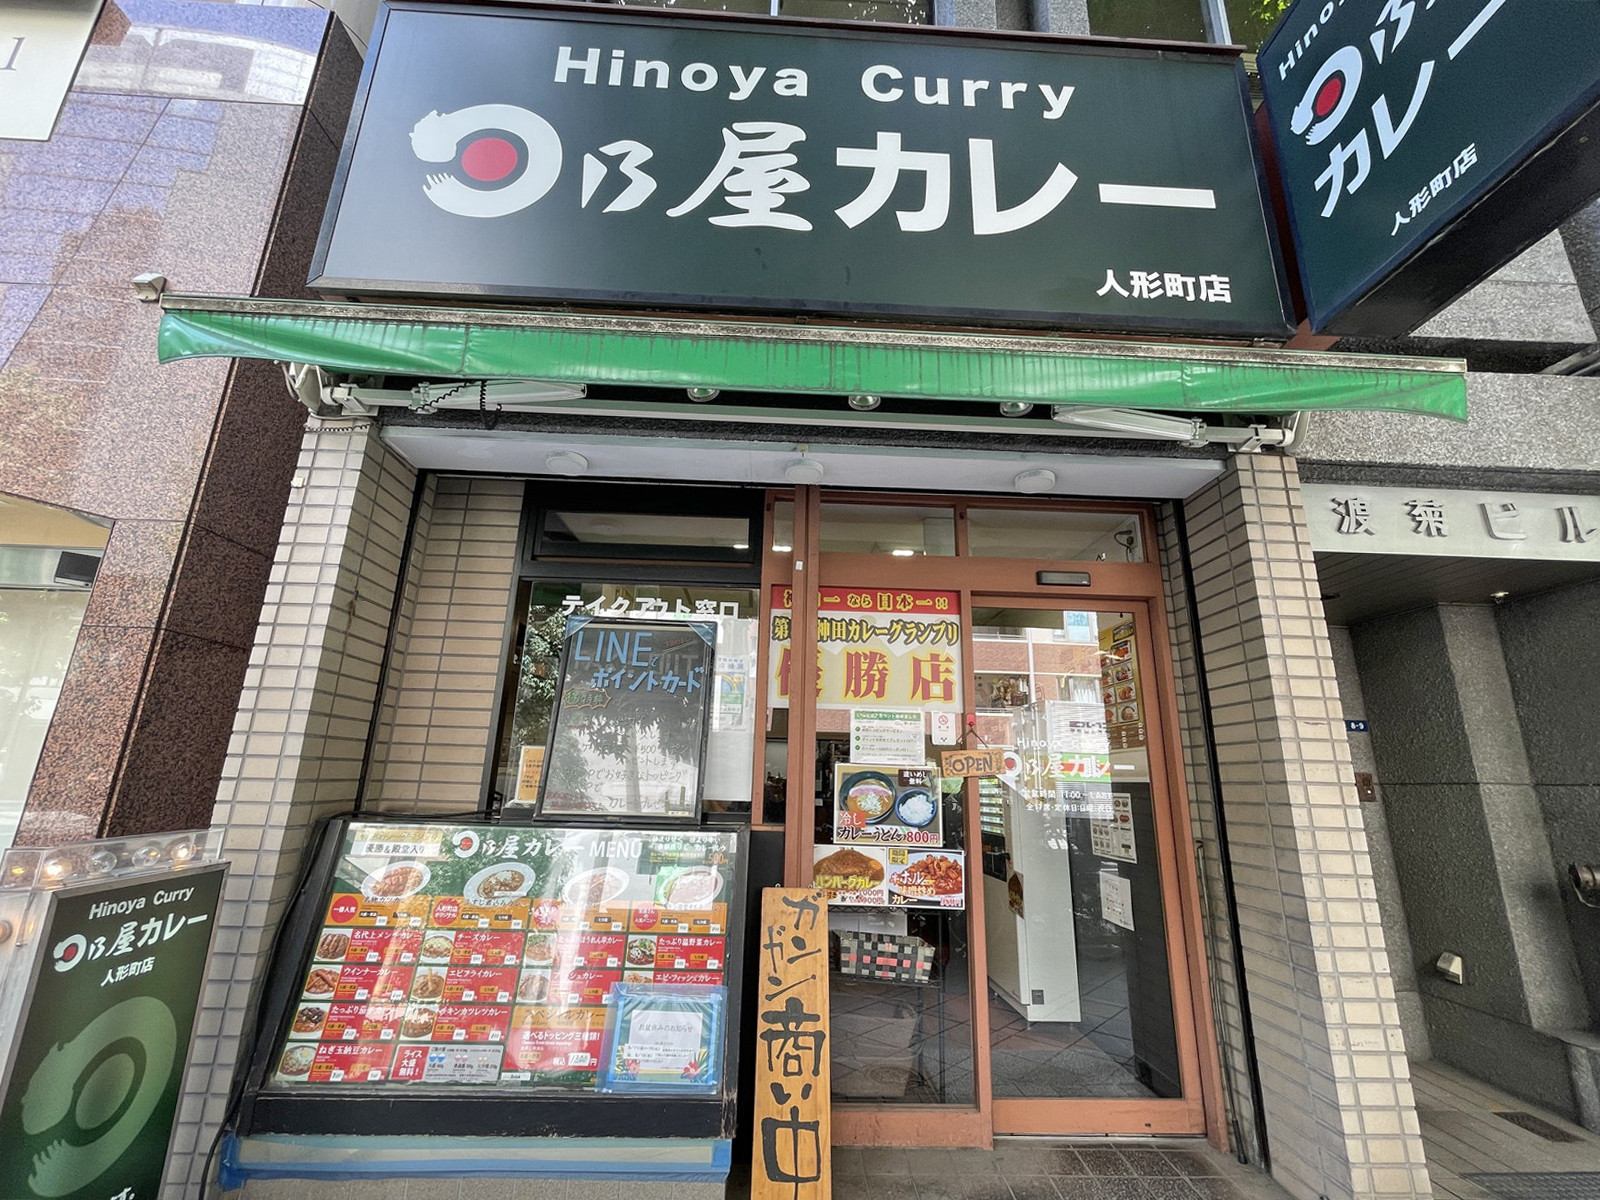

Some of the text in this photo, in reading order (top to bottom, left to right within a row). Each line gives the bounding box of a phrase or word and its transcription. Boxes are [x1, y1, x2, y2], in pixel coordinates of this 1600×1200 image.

[554, 46, 1075, 119] Hinoya Curry
[1391, 143, 1478, 236] 人形町店
[1096, 269, 1232, 303] 人形町店
[561, 594, 739, 620] テイクアウト窓口
[590, 666, 705, 694] ポイントカード
[952, 755, 993, 773] OPEN
[839, 811, 862, 826] 冷し
[906, 831, 939, 843] 800円
[589, 840, 643, 858] MENU
[88, 885, 195, 920] Hinoya Curry
[891, 895, 918, 905] カレー
[100, 956, 156, 987] 人形町店
[448, 969, 503, 979] エビフライカレー
[404, 1050, 423, 1059] ライス
